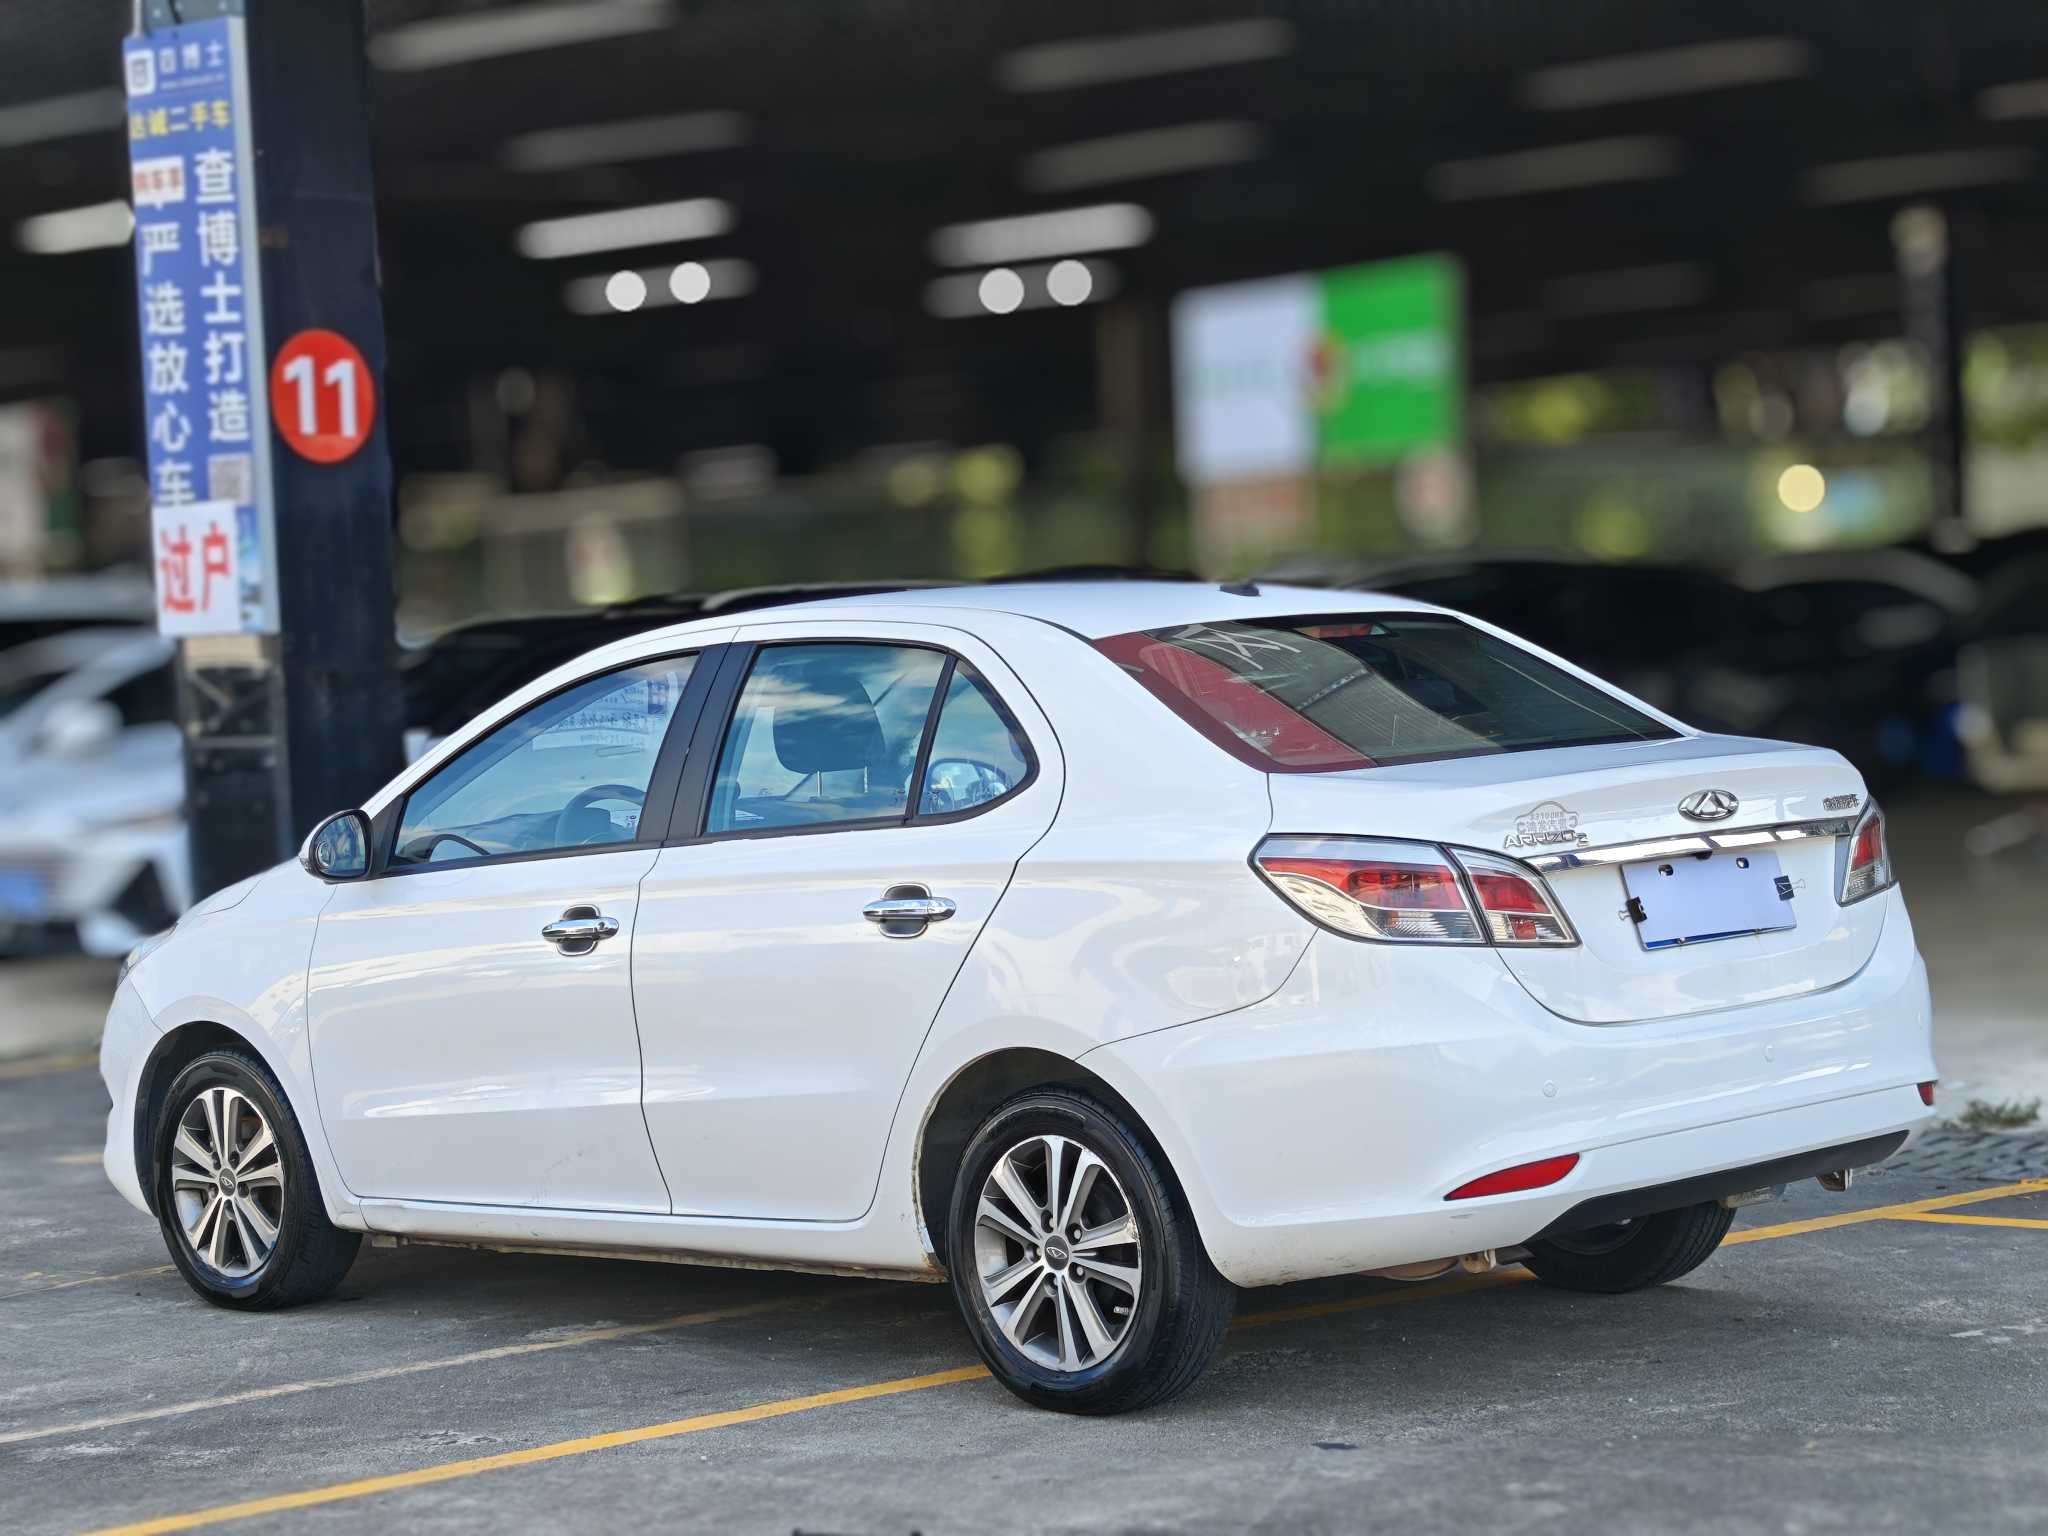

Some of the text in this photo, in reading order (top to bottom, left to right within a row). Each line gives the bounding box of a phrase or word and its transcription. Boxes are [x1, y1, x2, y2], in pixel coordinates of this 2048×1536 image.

[138, 203, 196, 507] 严选放心车
[194, 147, 250, 442] 查博士打造
[283, 355, 357, 438] 11
